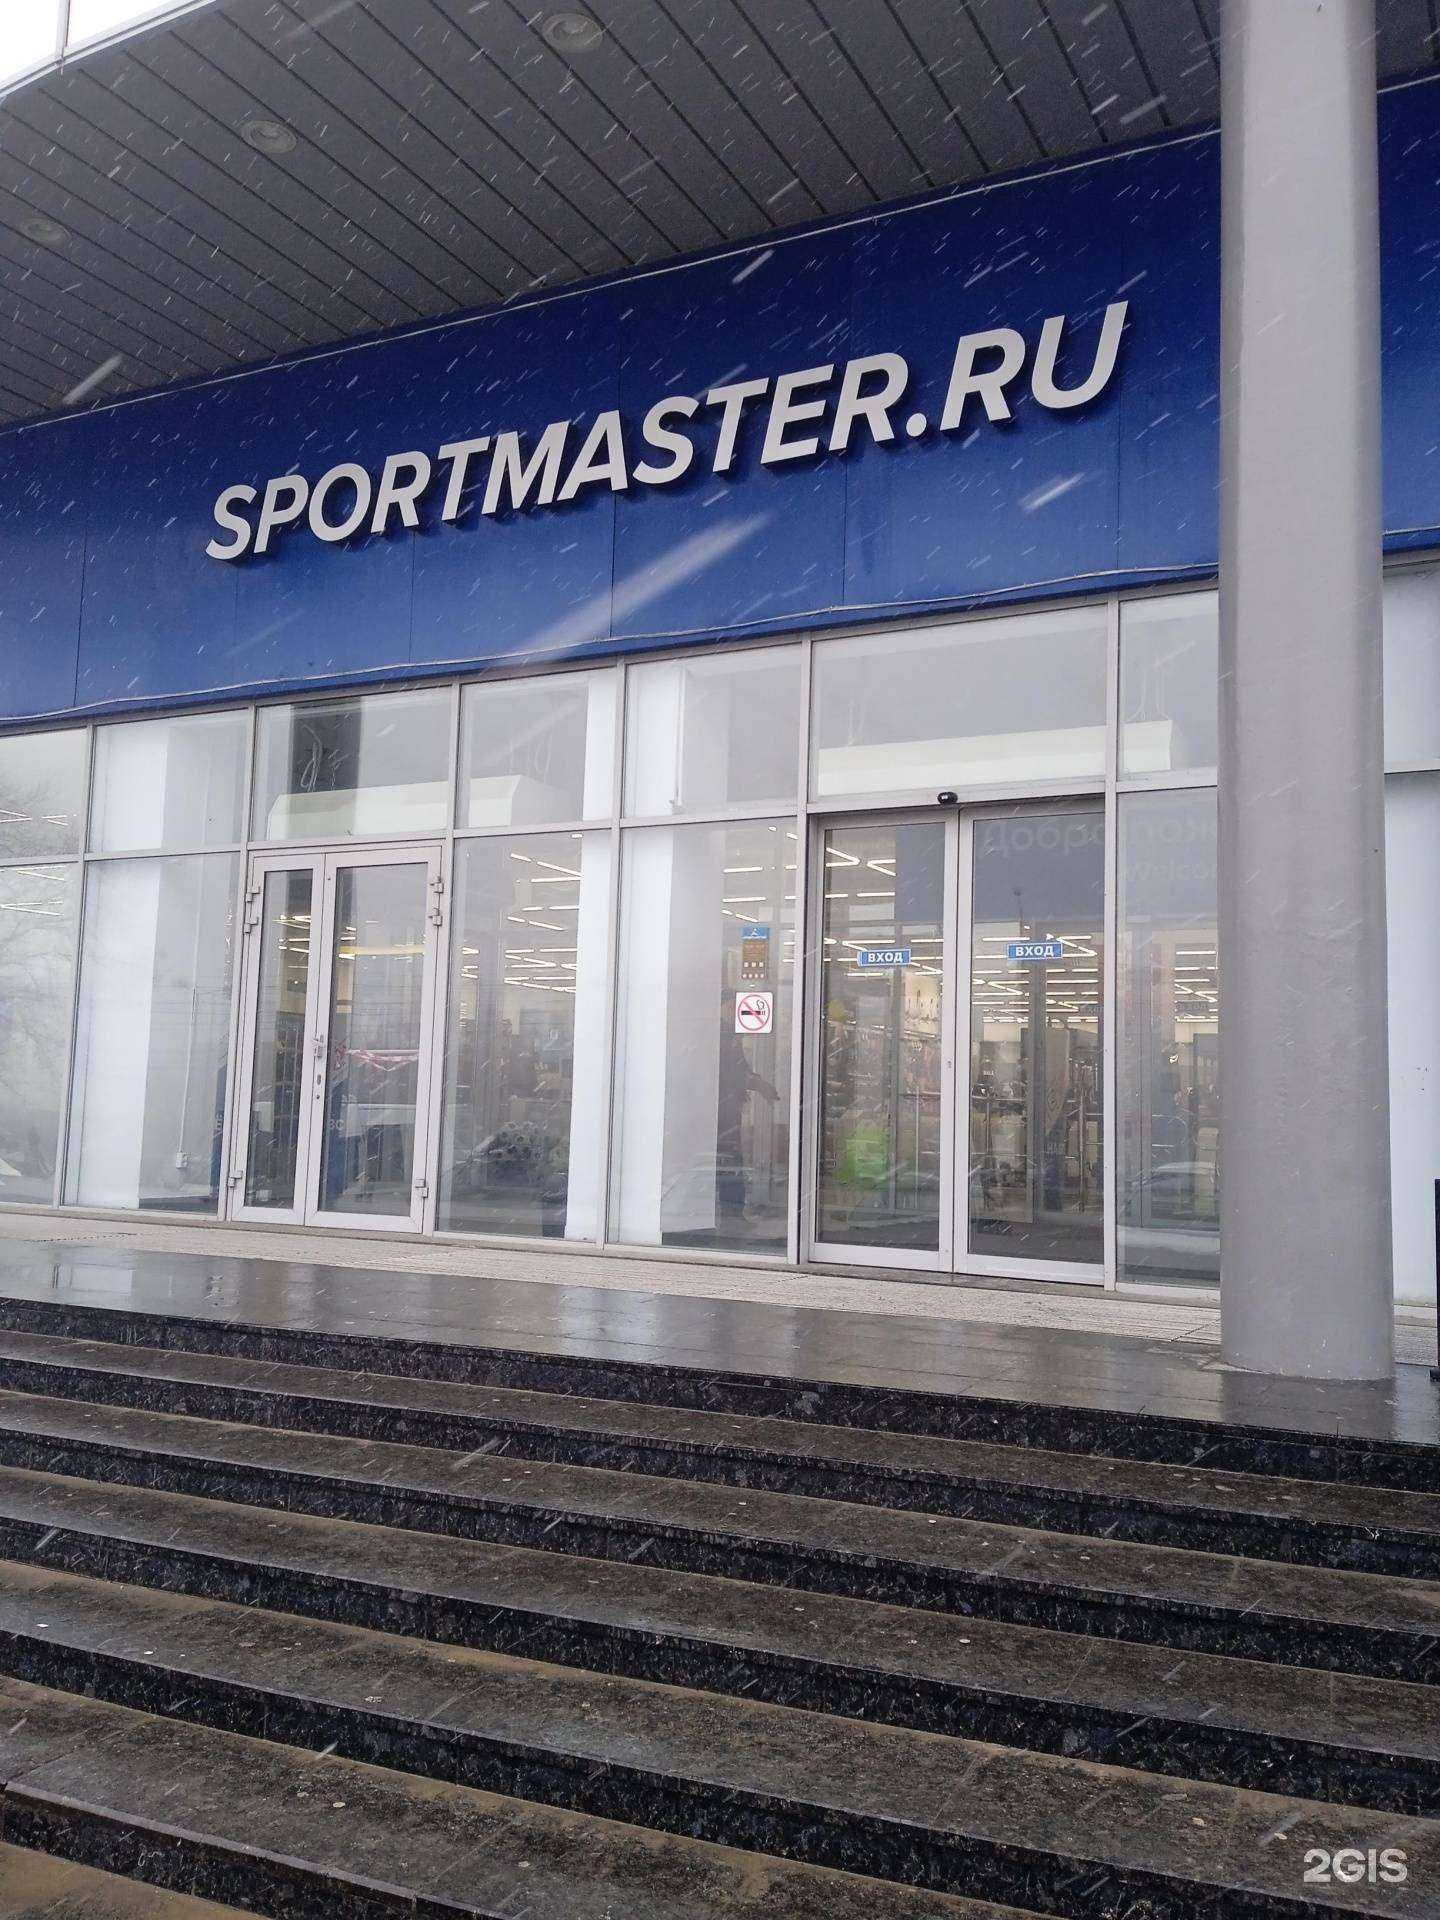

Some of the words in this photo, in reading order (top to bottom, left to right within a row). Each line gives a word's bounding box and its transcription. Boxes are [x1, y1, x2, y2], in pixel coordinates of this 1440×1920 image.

[206, 301, 1129, 562] SPORTMASTER.RU
[867, 952, 903, 963] ВХОД
[1015, 945, 1055, 958] ВХОД
